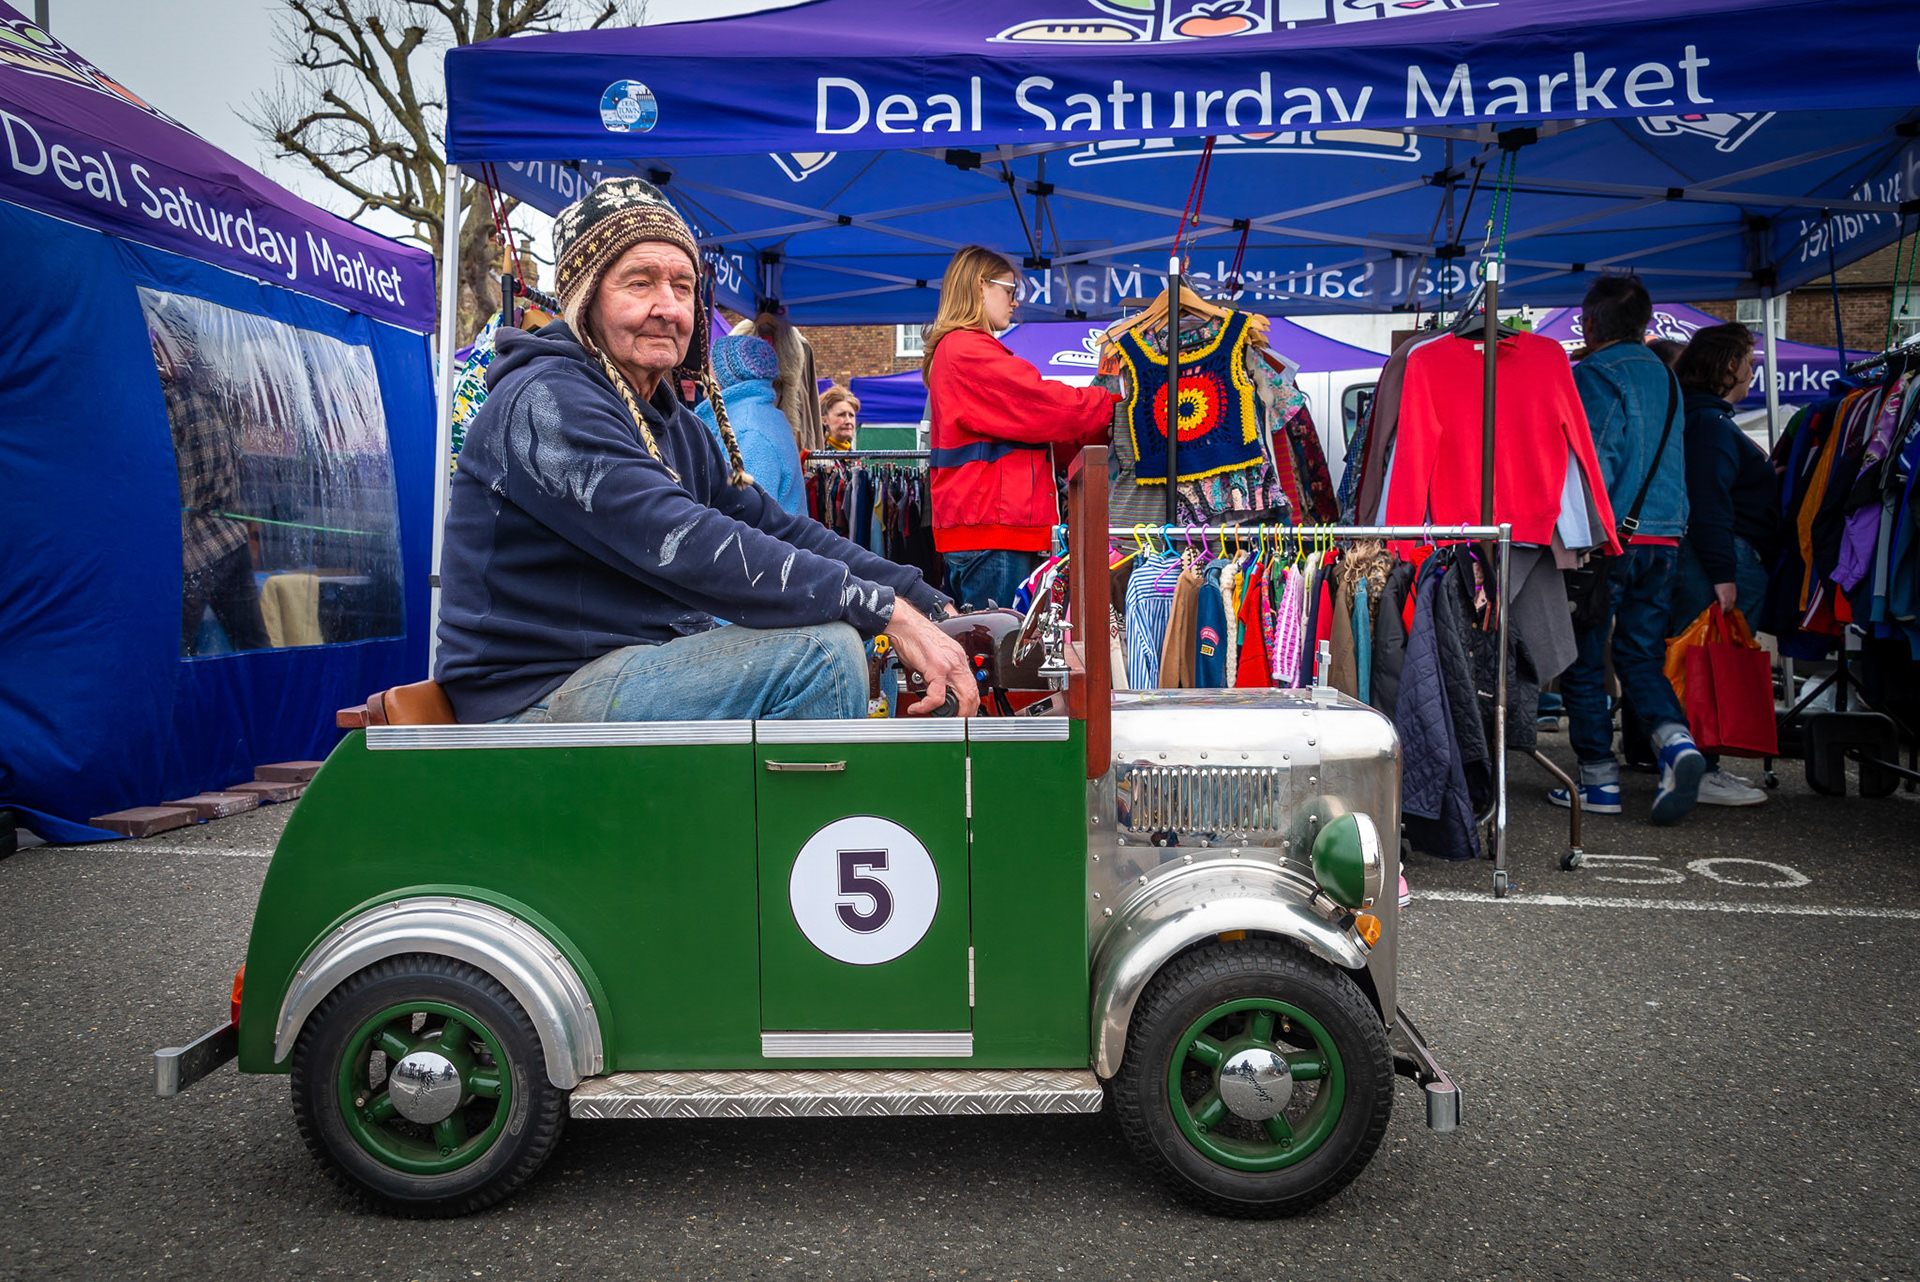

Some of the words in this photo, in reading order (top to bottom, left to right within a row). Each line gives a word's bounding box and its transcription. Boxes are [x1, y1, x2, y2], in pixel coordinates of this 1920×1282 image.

[816, 76, 981, 134] Deal
[1015, 71, 1373, 131] Saturday
[1405, 45, 1714, 119] Market
[0, 109, 127, 207] Deal
[131, 164, 297, 280] Saturday
[305, 231, 405, 306] Market
[835, 848, 894, 934] 5
[1578, 853, 1812, 888] 50
